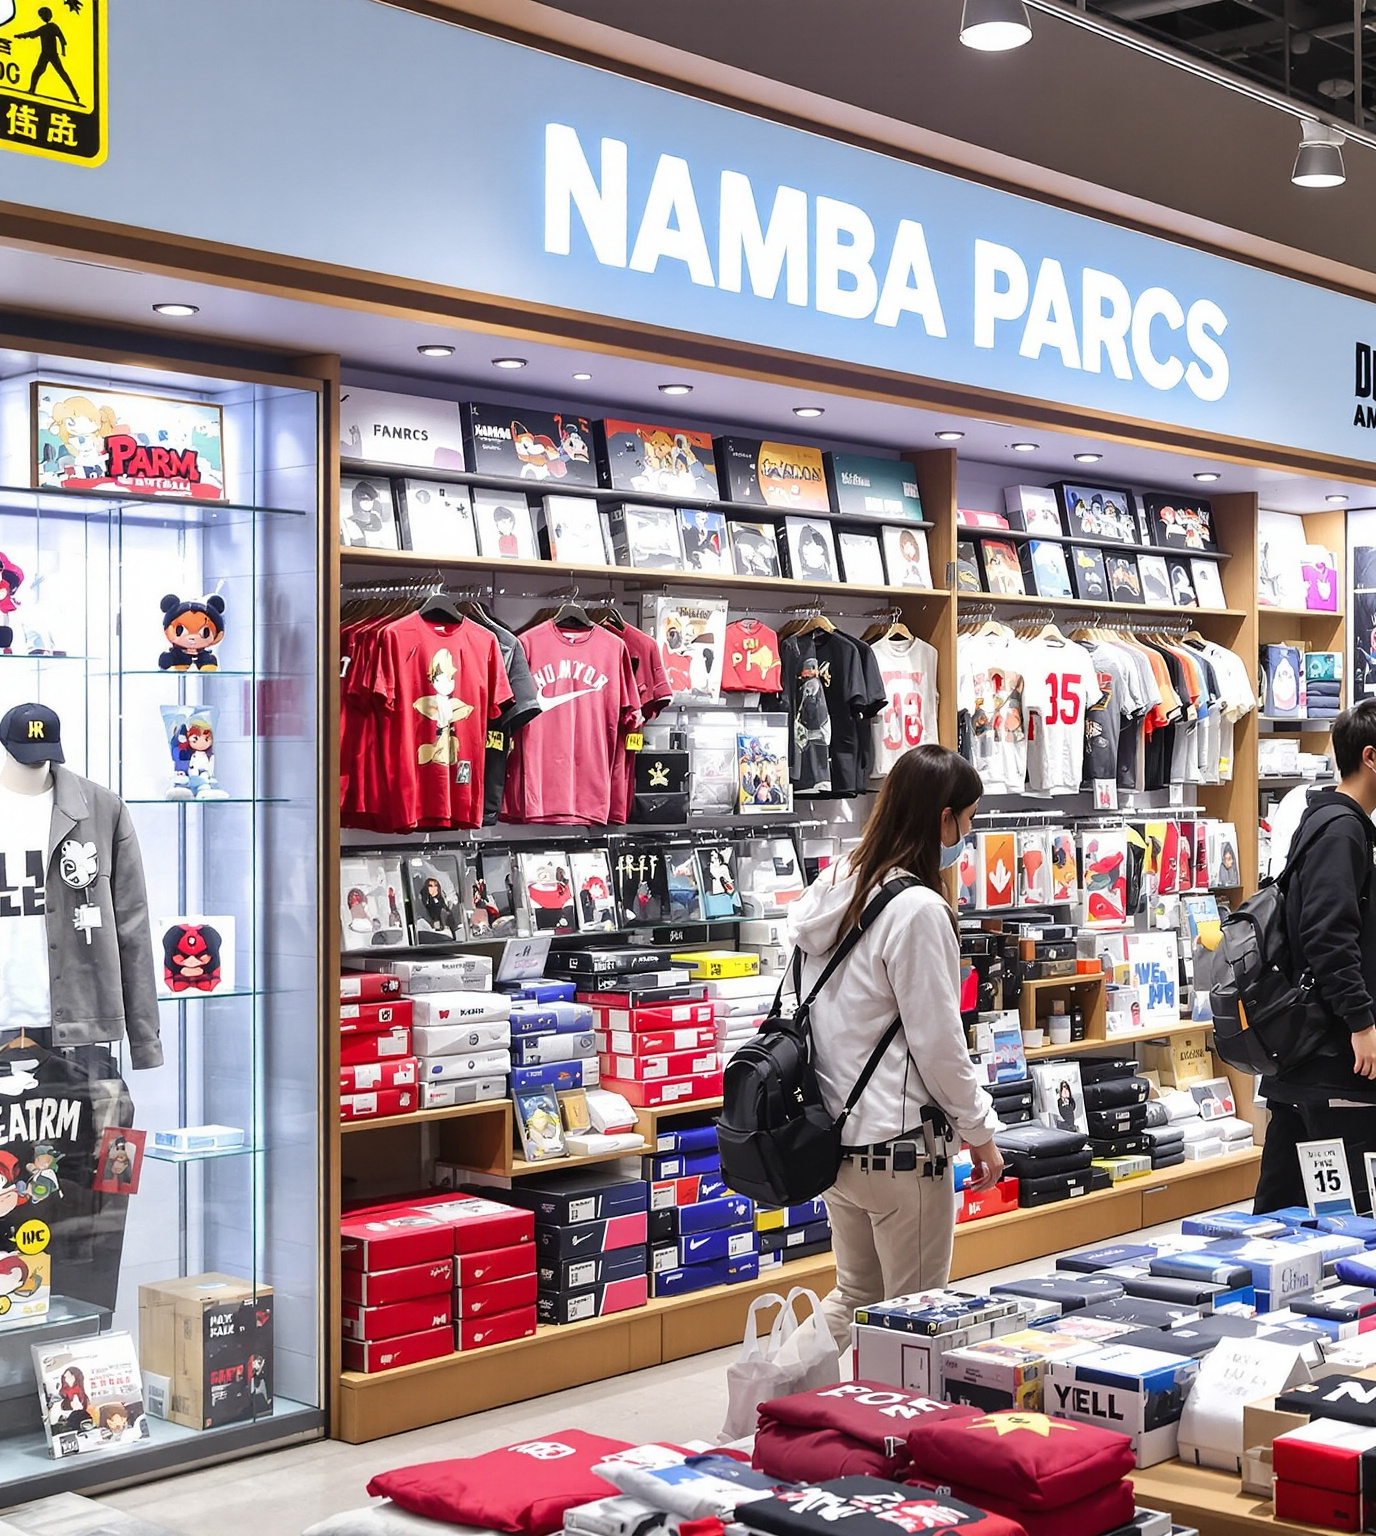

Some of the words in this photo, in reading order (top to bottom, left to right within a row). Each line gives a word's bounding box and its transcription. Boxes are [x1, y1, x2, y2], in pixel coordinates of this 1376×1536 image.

[544, 123, 948, 338] NAMBA
[974, 238, 1230, 403] PARCS
[373, 424, 429, 441] FANRCS
[105, 434, 200, 482] PARM
[1313, 1169, 1342, 1193] 15
[1053, 1383, 1124, 1421] YELL
